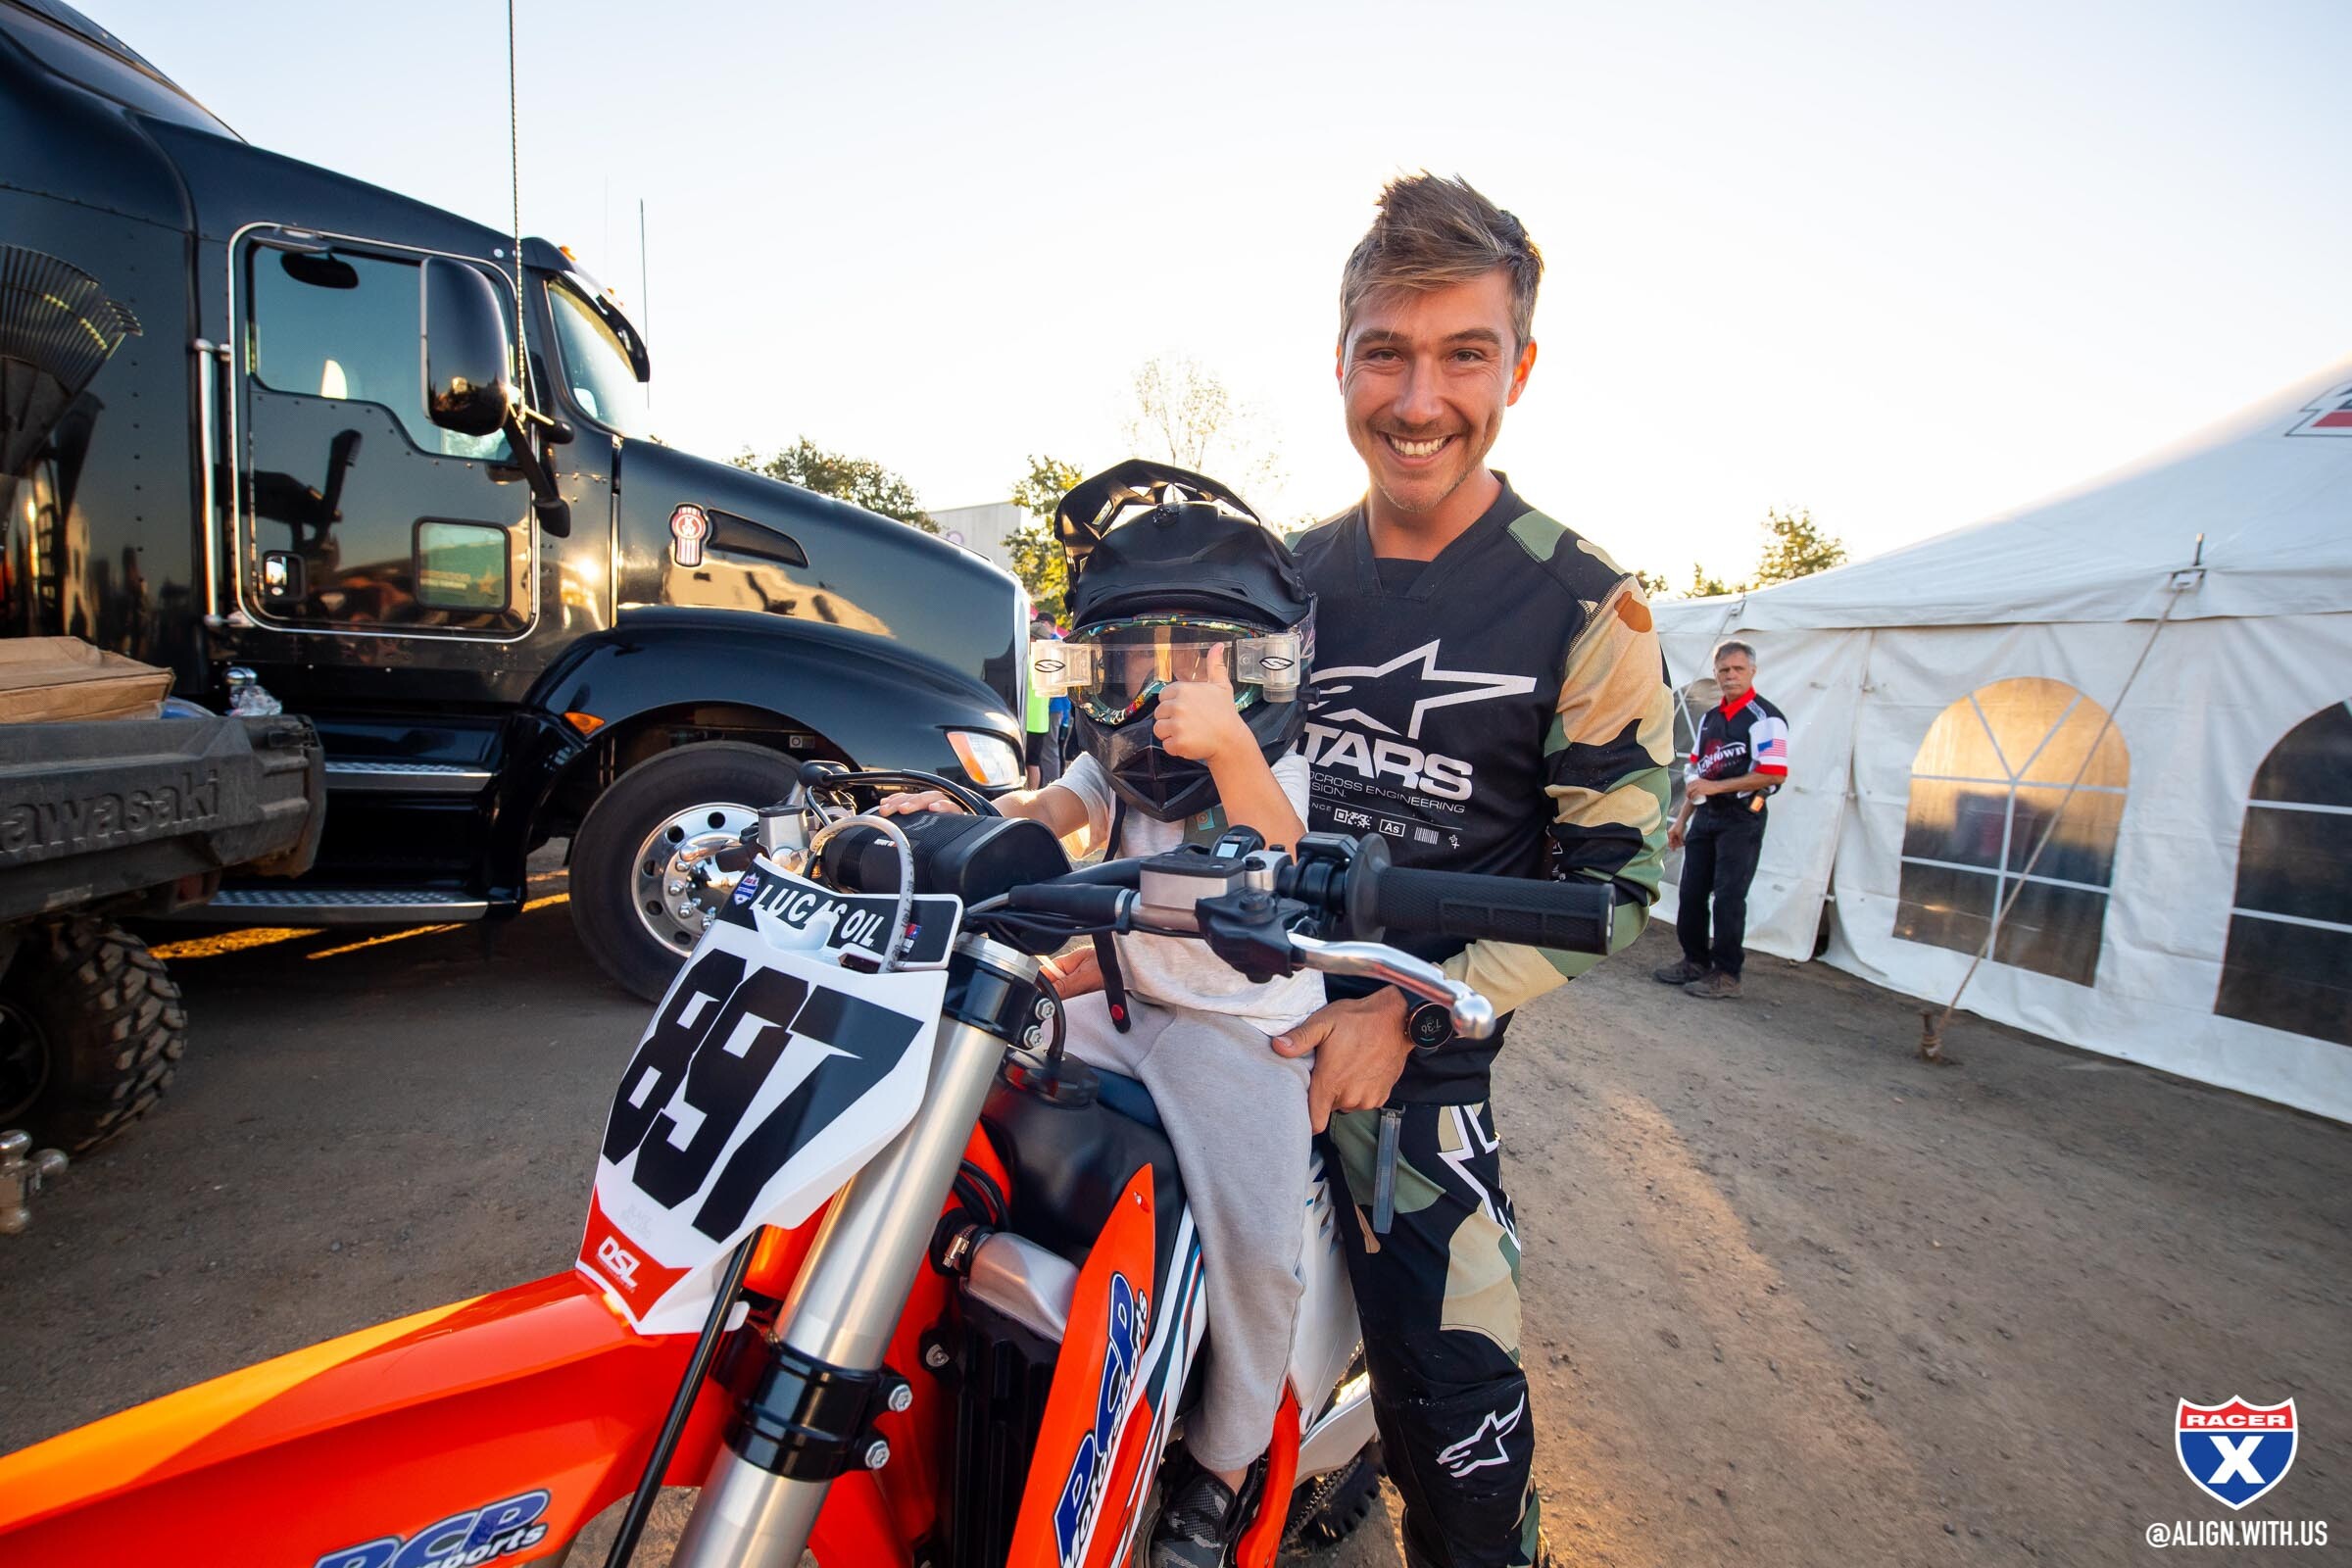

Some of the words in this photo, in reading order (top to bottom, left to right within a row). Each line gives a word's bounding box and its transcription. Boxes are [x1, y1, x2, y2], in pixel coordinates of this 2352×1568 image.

[1286, 722, 1473, 801] TARS
[1308, 802, 1333, 812] NCE
[1311, 782, 1347, 798] SION.
[1366, 786, 1465, 813] ENGINEERING
[0, 769, 220, 853] awasaki
[1384, 822, 1400, 835] As
[840, 908, 884, 948] OIL
[602, 948, 925, 1245] 897
[597, 1235, 641, 1289] DSL
